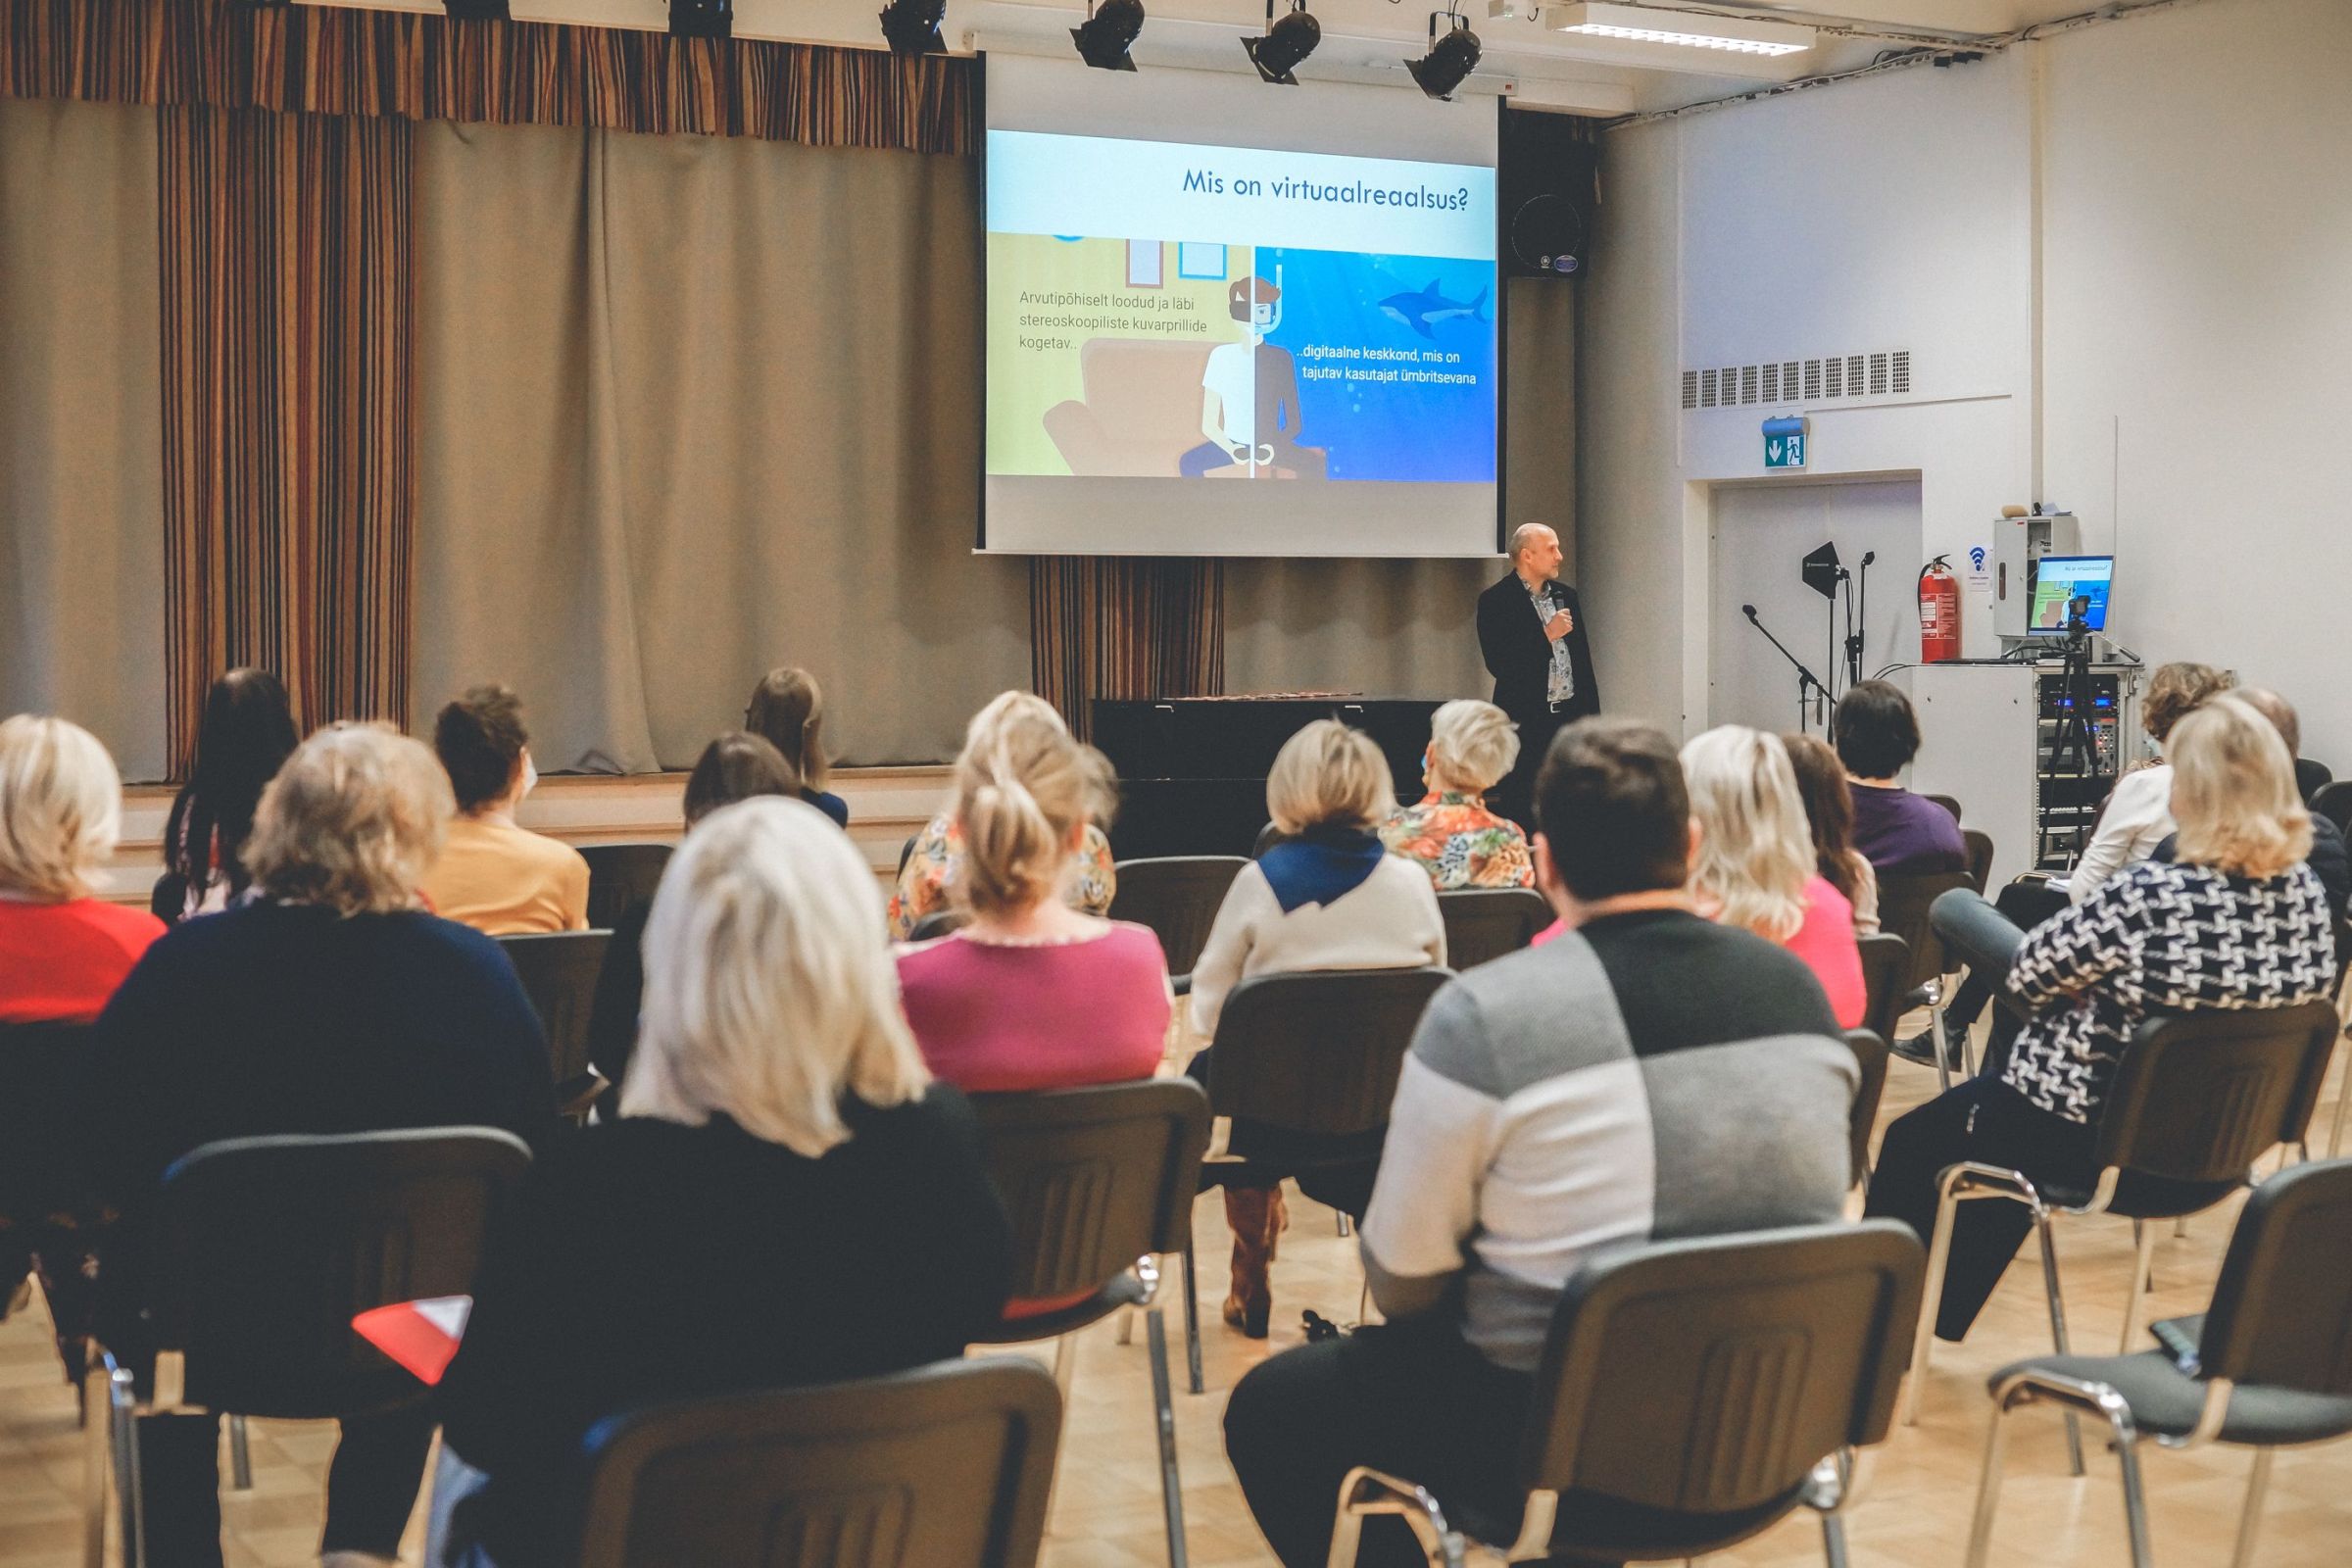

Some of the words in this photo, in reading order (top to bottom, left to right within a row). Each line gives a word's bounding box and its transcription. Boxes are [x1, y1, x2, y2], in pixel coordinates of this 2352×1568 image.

[1183, 169, 1224, 194] Mis
[1234, 179, 1261, 196] on
[1271, 176, 1469, 211] virtuaalreaalsus?
[1019, 291, 1108, 308] Arvutipõhiselt
[1112, 294, 1154, 309] loodud
[1157, 297, 1169, 312] ja
[1172, 297, 1195, 311] läbi
[1019, 314, 1129, 330] stereoskoopiliste
[1133, 318, 1207, 333] kuvarprillide
[1019, 335, 1077, 352] kogetav..
[1296, 344, 1360, 361] ..digitaalne
[1363, 346, 1420, 363] keskkond,
[1422, 349, 1444, 363] mis
[1446, 353, 1460, 364] on
[1301, 366, 1343, 380] tajutav
[1346, 367, 1398, 383] kasutajat
[1401, 369, 1477, 384] ümbritsevana
